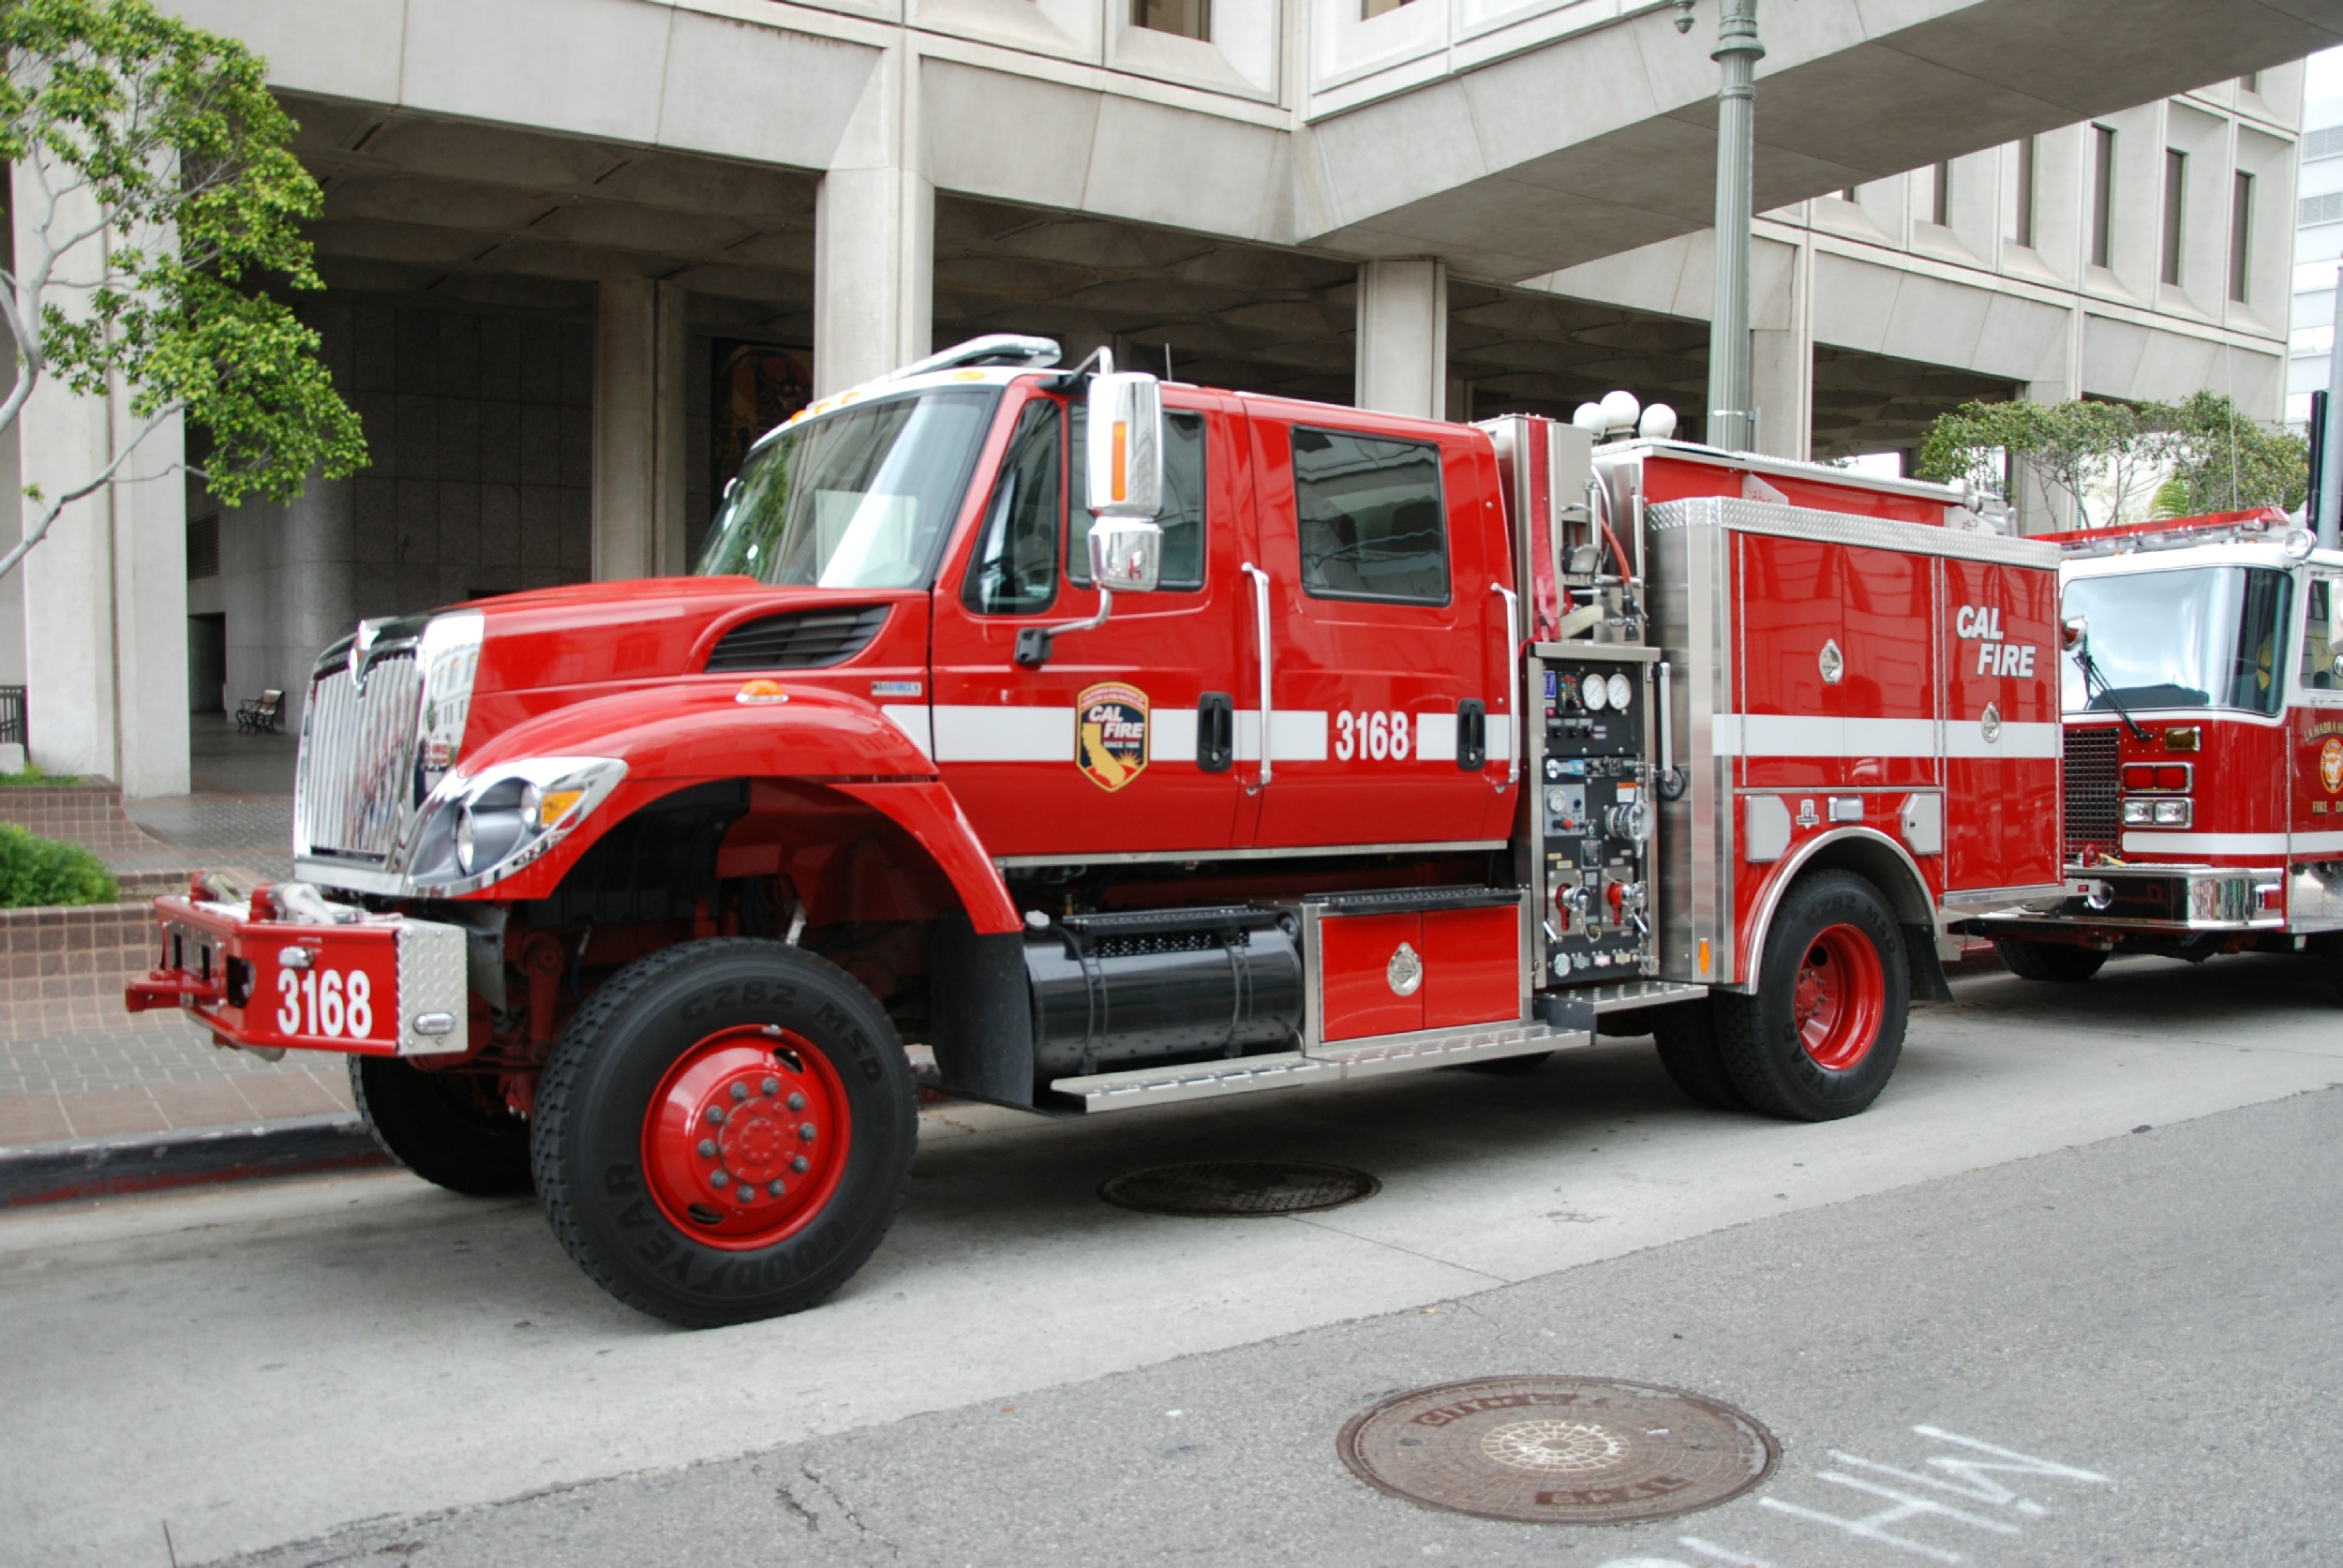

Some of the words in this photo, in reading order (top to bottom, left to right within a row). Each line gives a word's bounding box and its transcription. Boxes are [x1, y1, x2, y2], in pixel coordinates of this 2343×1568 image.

[1956, 605, 2004, 640] CAL
[1977, 643, 2037, 678] FIRE
[1088, 705, 1124, 723] CAL
[1103, 723, 1144, 739] FIRE
[1336, 710, 1410, 761] 3168
[2312, 800, 2328, 814] FIRE
[277, 968, 373, 1038] 3168
[814, 1003, 882, 1080] MSD
[605, 1162, 844, 1292] GOODYEAR
[1418, 1399, 1483, 1425] CITY
